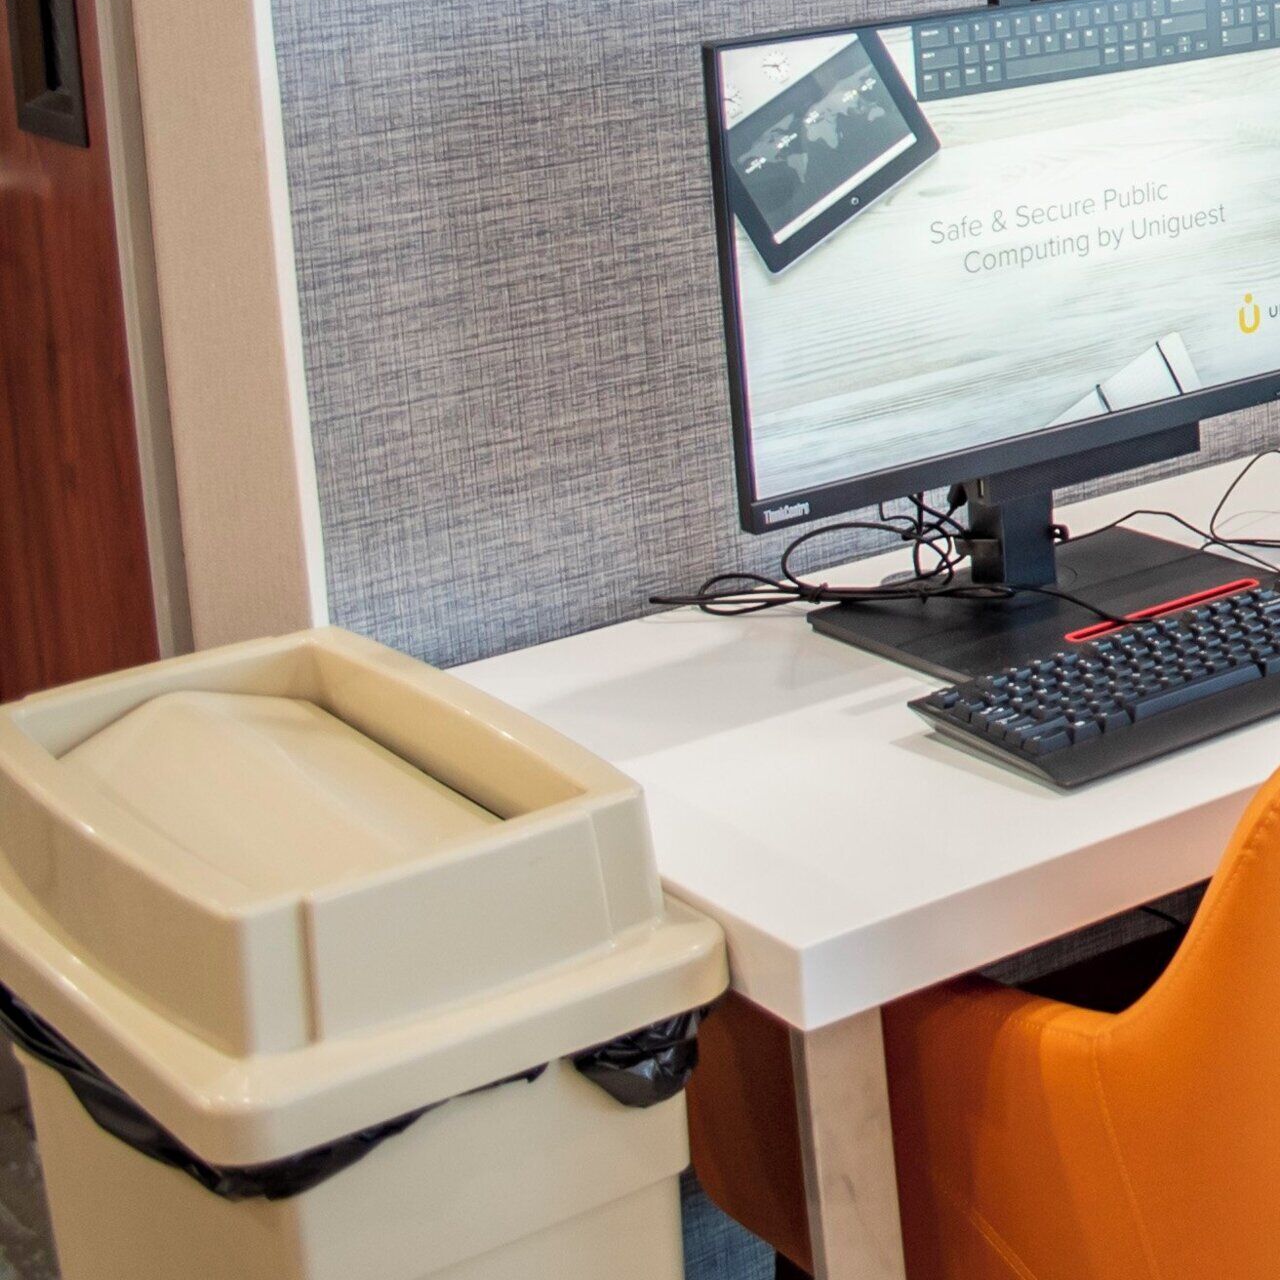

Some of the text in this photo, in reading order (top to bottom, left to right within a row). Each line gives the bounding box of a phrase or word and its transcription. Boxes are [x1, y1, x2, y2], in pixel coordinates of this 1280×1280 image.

[930, 181, 1169, 245] Safe & Secure Public
[963, 203, 1226, 274] Computing by Uniguest
